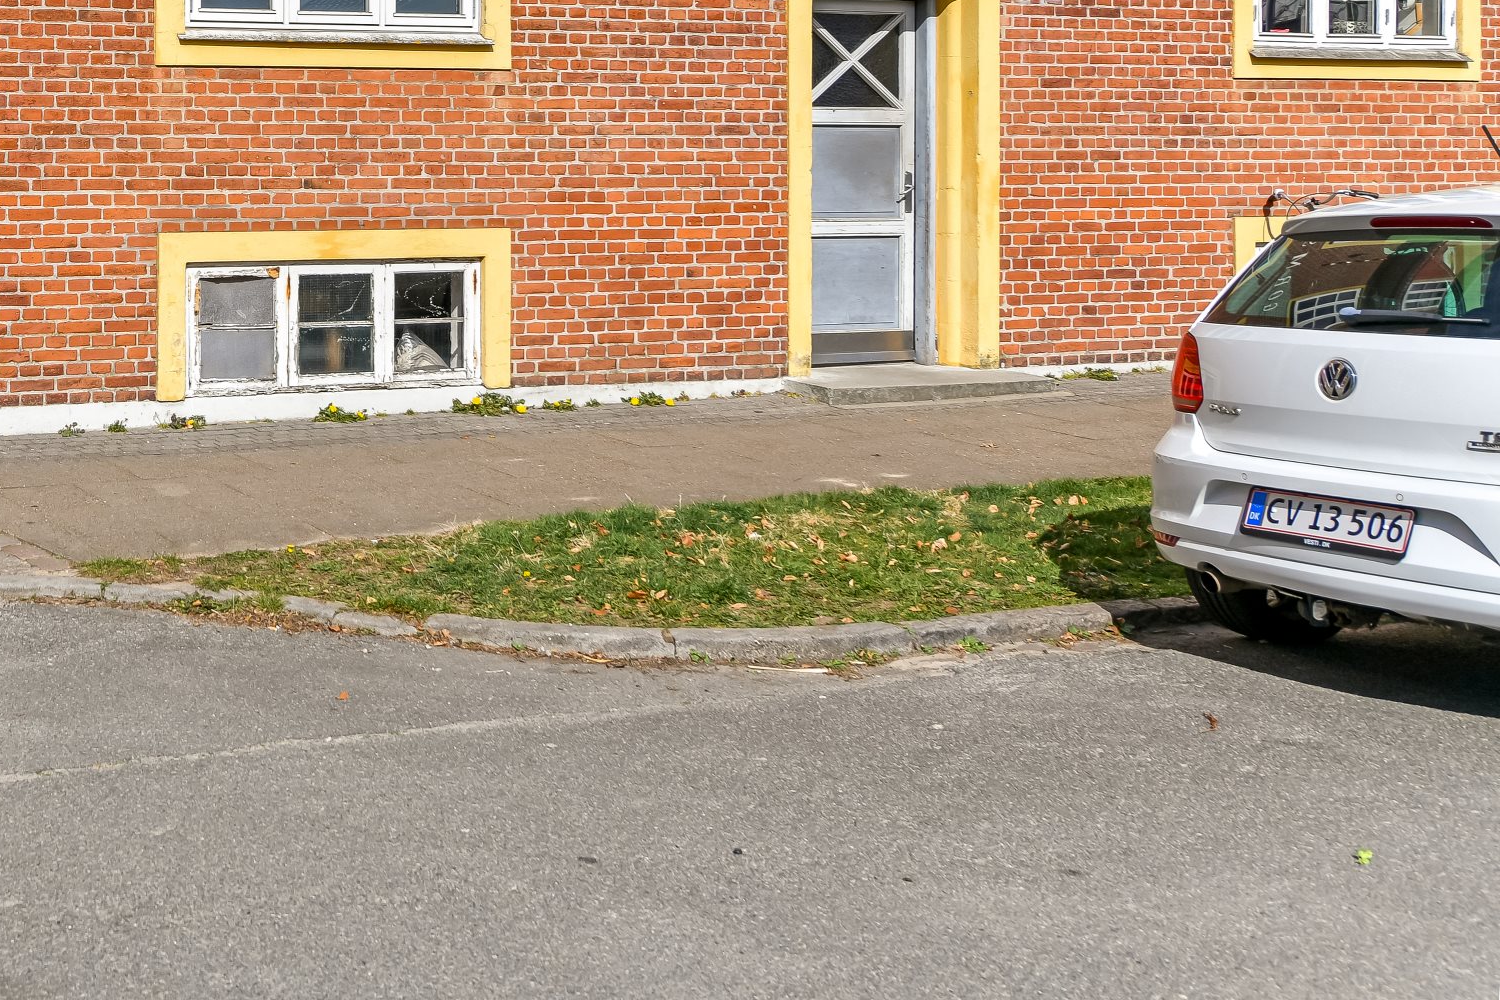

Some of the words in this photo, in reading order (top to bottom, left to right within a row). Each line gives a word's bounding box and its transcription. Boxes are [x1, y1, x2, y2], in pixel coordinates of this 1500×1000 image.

[1250, 511, 1260, 521] DK
[1266, 498, 1303, 526] CV
[1308, 503, 1342, 532] 13
[1347, 508, 1403, 543] 506
